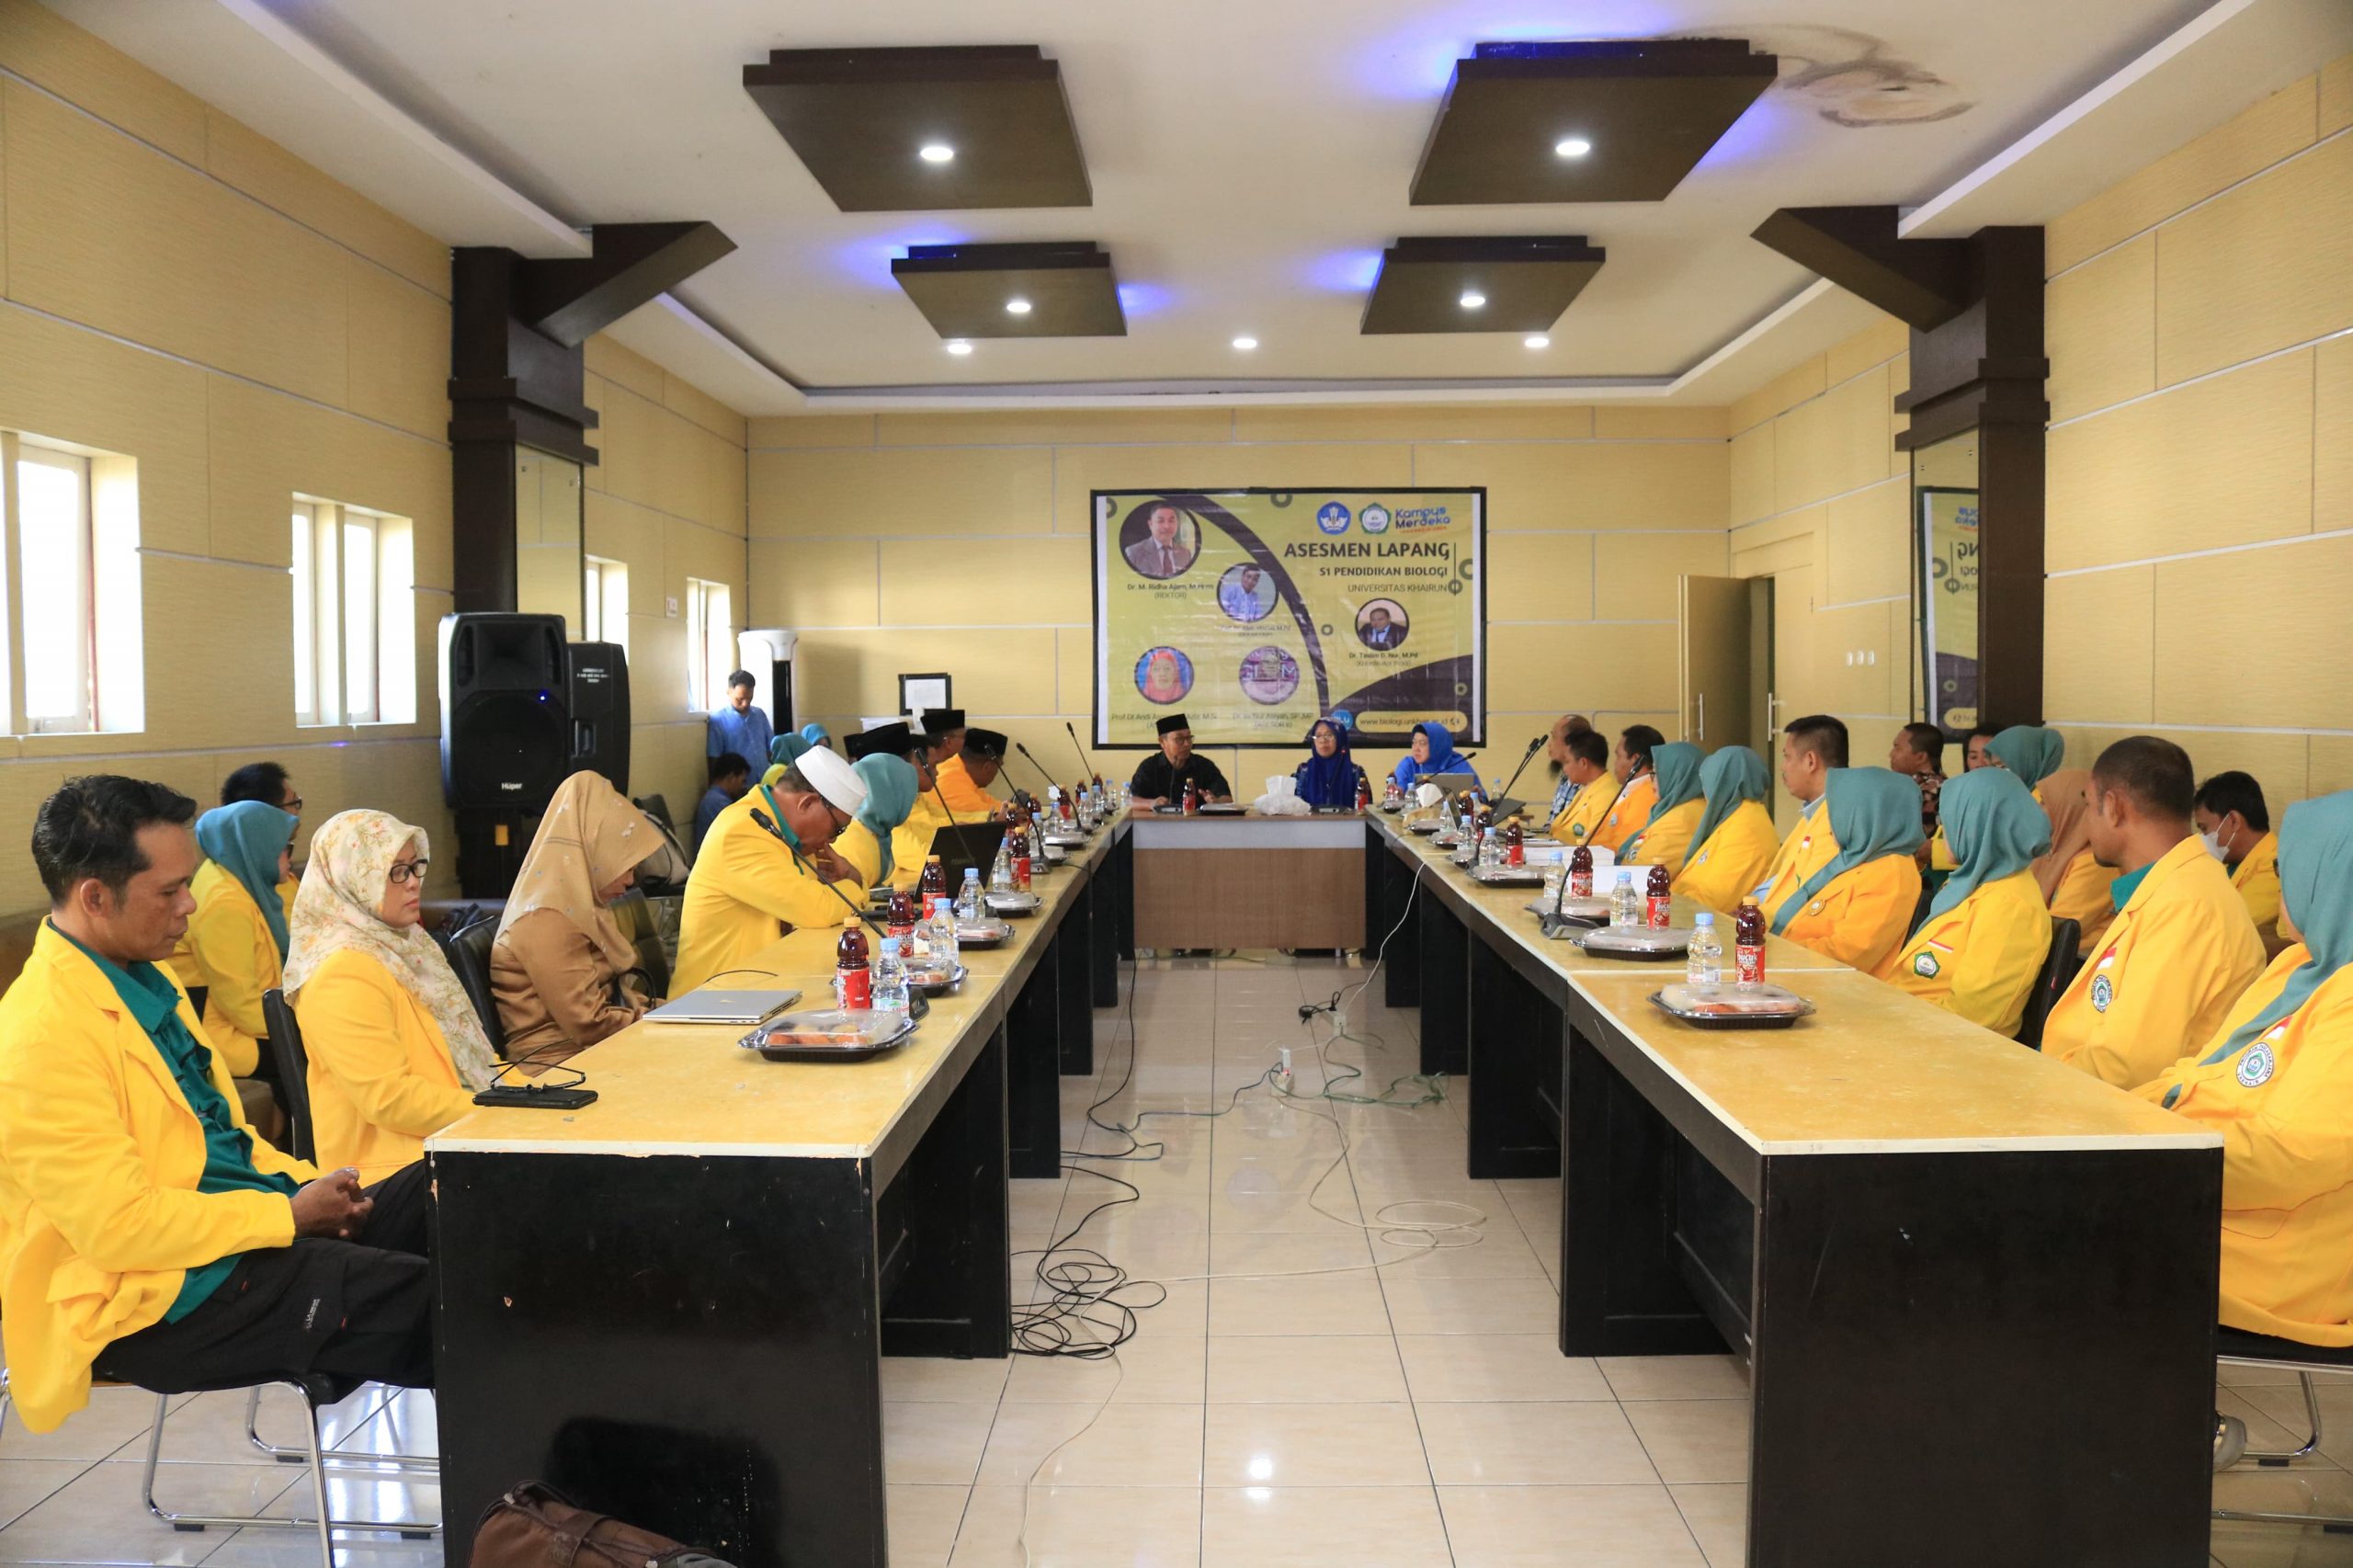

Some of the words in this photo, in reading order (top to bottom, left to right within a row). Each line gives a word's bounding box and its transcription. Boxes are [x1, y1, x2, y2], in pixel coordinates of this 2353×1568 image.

[1395, 506, 1447, 519] Kampus
[1395, 516, 1450, 529] Merdeka
[1284, 542, 1370, 558] ASESMEN
[1378, 542, 1449, 560] LAPANG
[1320, 567, 1330, 576] S1
[1335, 567, 1401, 576] PENDIDIKAN
[1404, 567, 1448, 577] BIOLOGI
[1347, 584, 1405, 593] UNIVERSITAS
[1407, 583, 1448, 593] KHAIRUN
